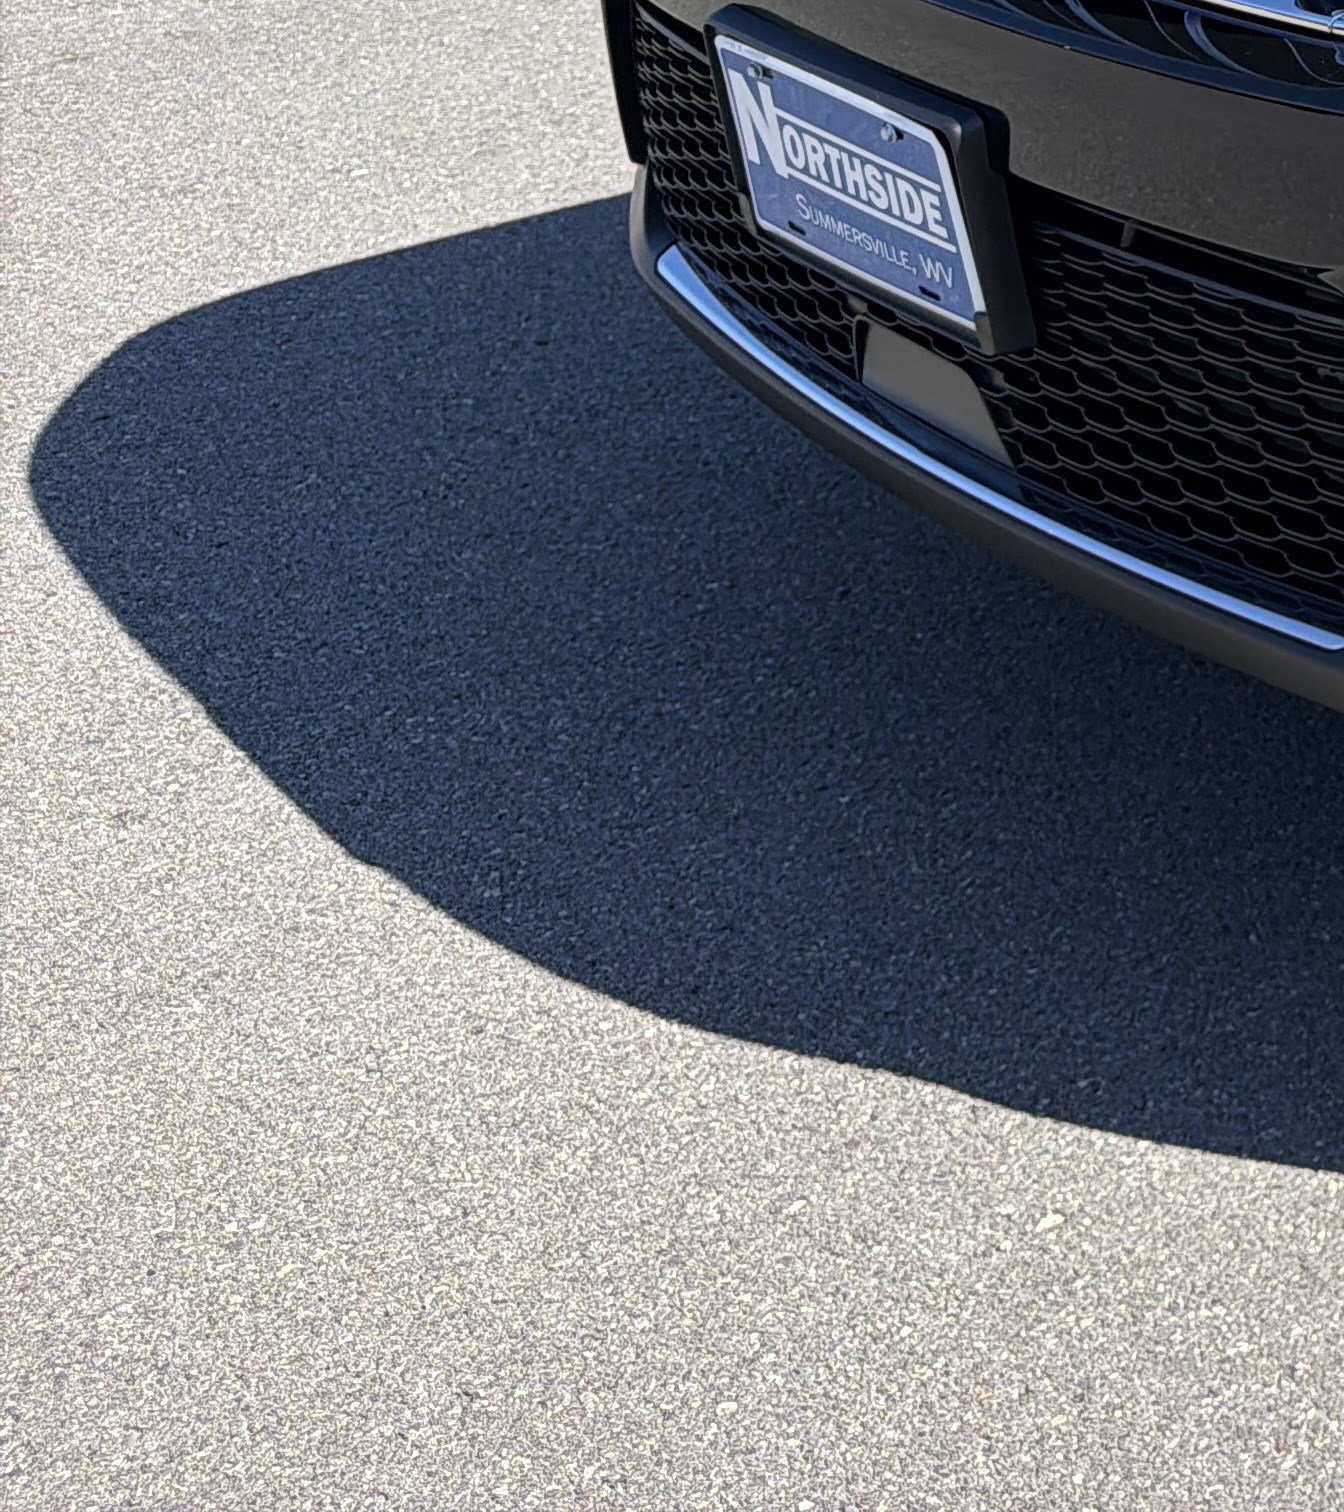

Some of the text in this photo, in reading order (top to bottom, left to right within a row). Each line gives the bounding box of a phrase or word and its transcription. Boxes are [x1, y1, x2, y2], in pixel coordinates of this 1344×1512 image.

[729, 67, 949, 238] NORTHSIDE
[795, 193, 953, 288] SUMMERSVILLE, WV
